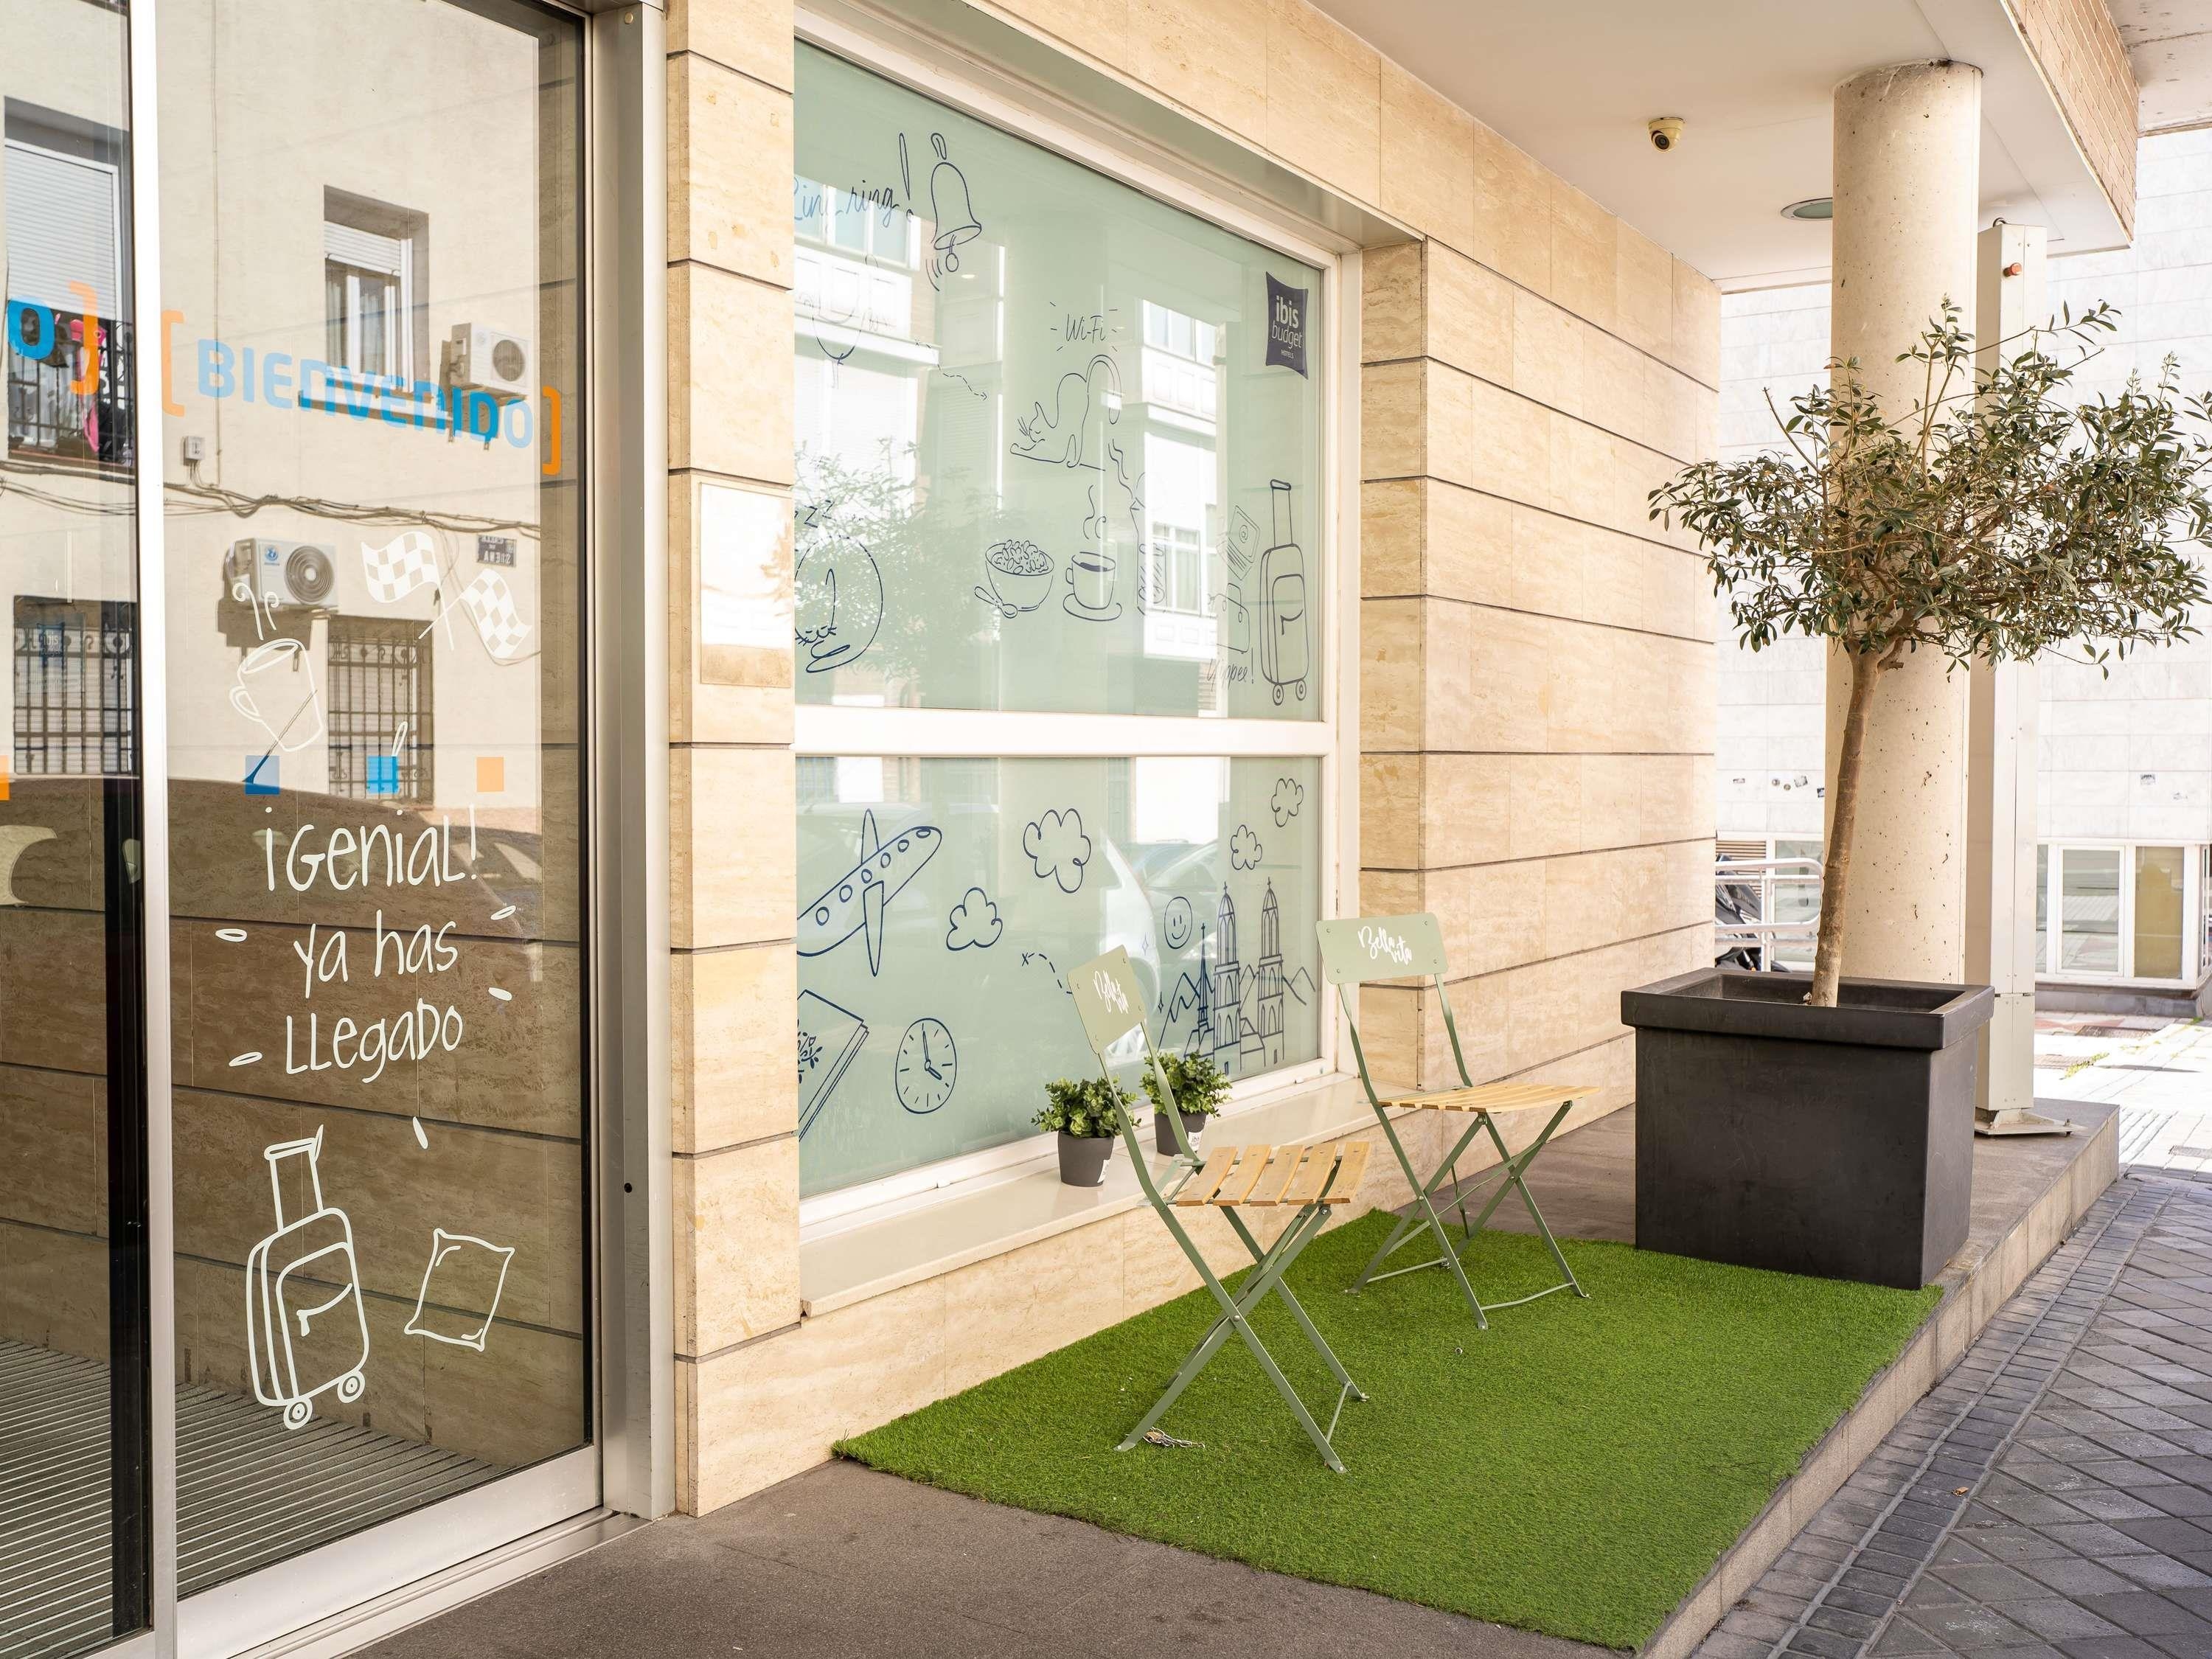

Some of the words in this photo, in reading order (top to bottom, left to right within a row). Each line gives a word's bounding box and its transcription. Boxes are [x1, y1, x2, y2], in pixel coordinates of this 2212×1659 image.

[1276, 295, 1298, 329] ibis
[1065, 313, 1107, 344] Wi-Fi
[1271, 320, 1303, 349] budget
[374, 909, 459, 977] has
